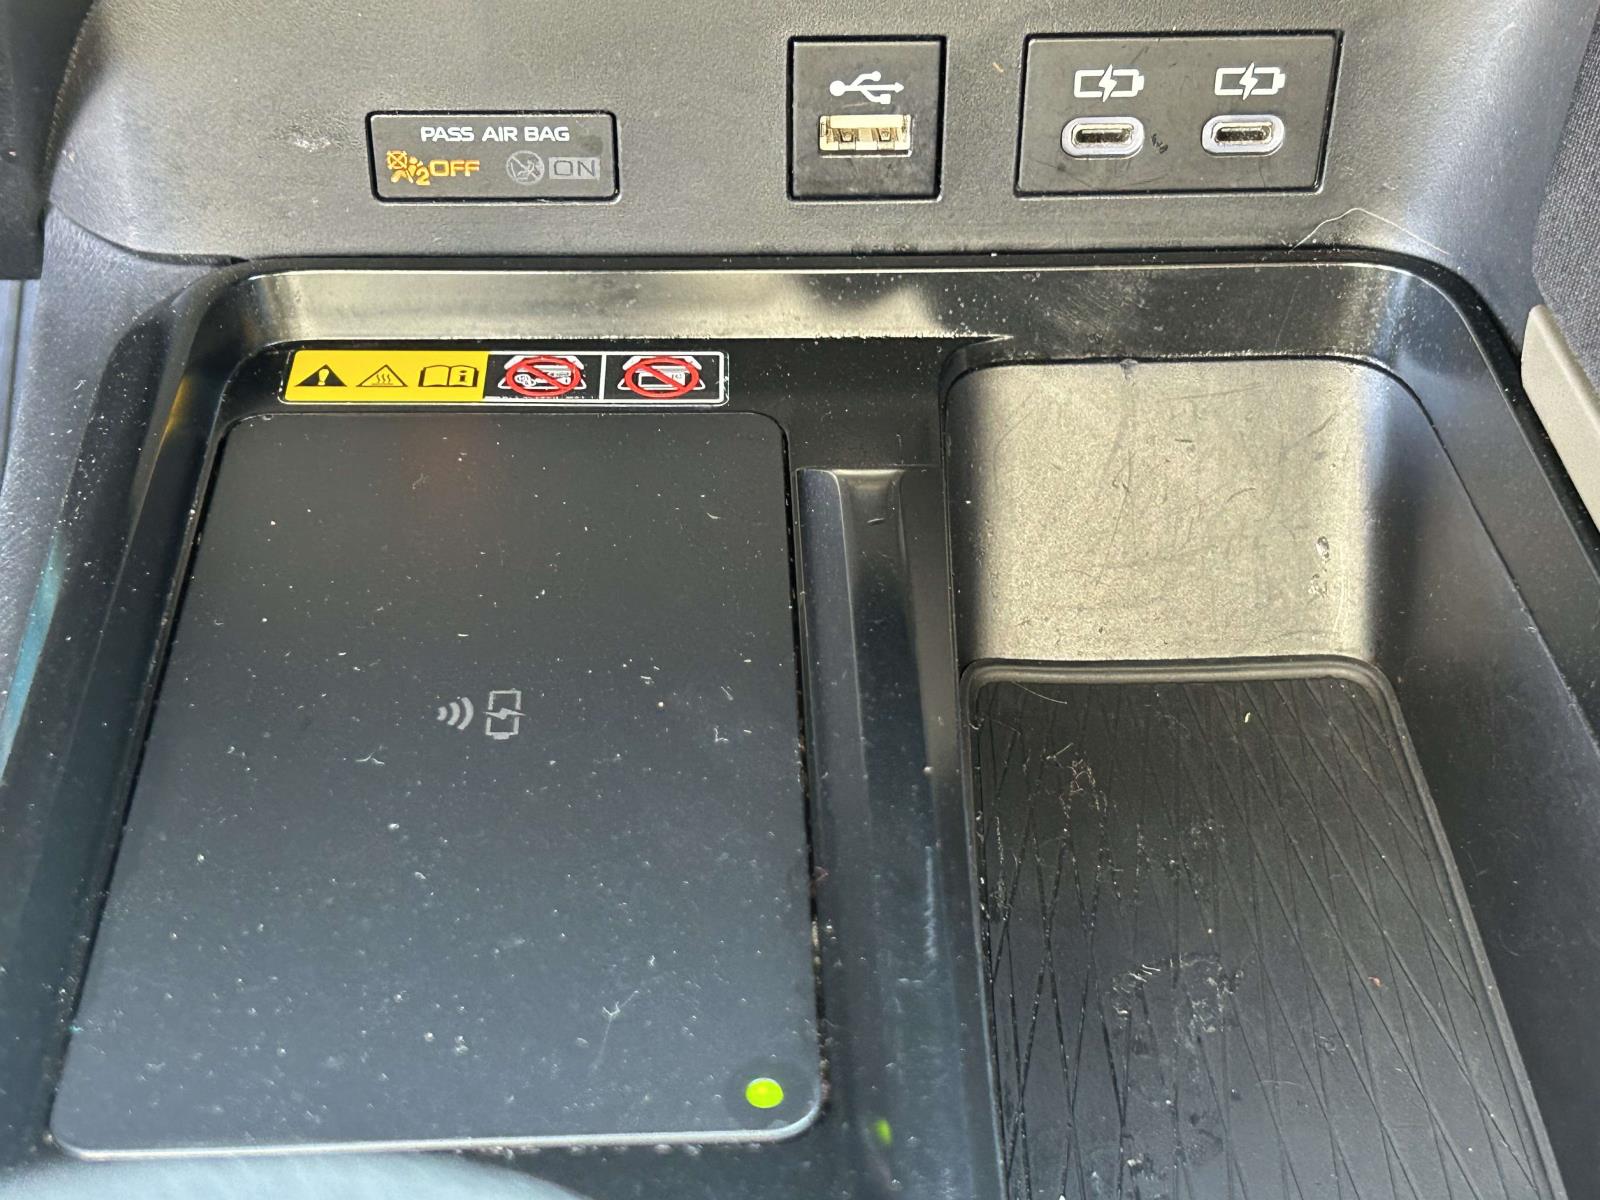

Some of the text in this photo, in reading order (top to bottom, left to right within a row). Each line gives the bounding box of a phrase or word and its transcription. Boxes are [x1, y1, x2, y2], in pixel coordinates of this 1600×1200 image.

[420, 126, 570, 142] PASS AIR BAG
[551, 158, 597, 177] ON
